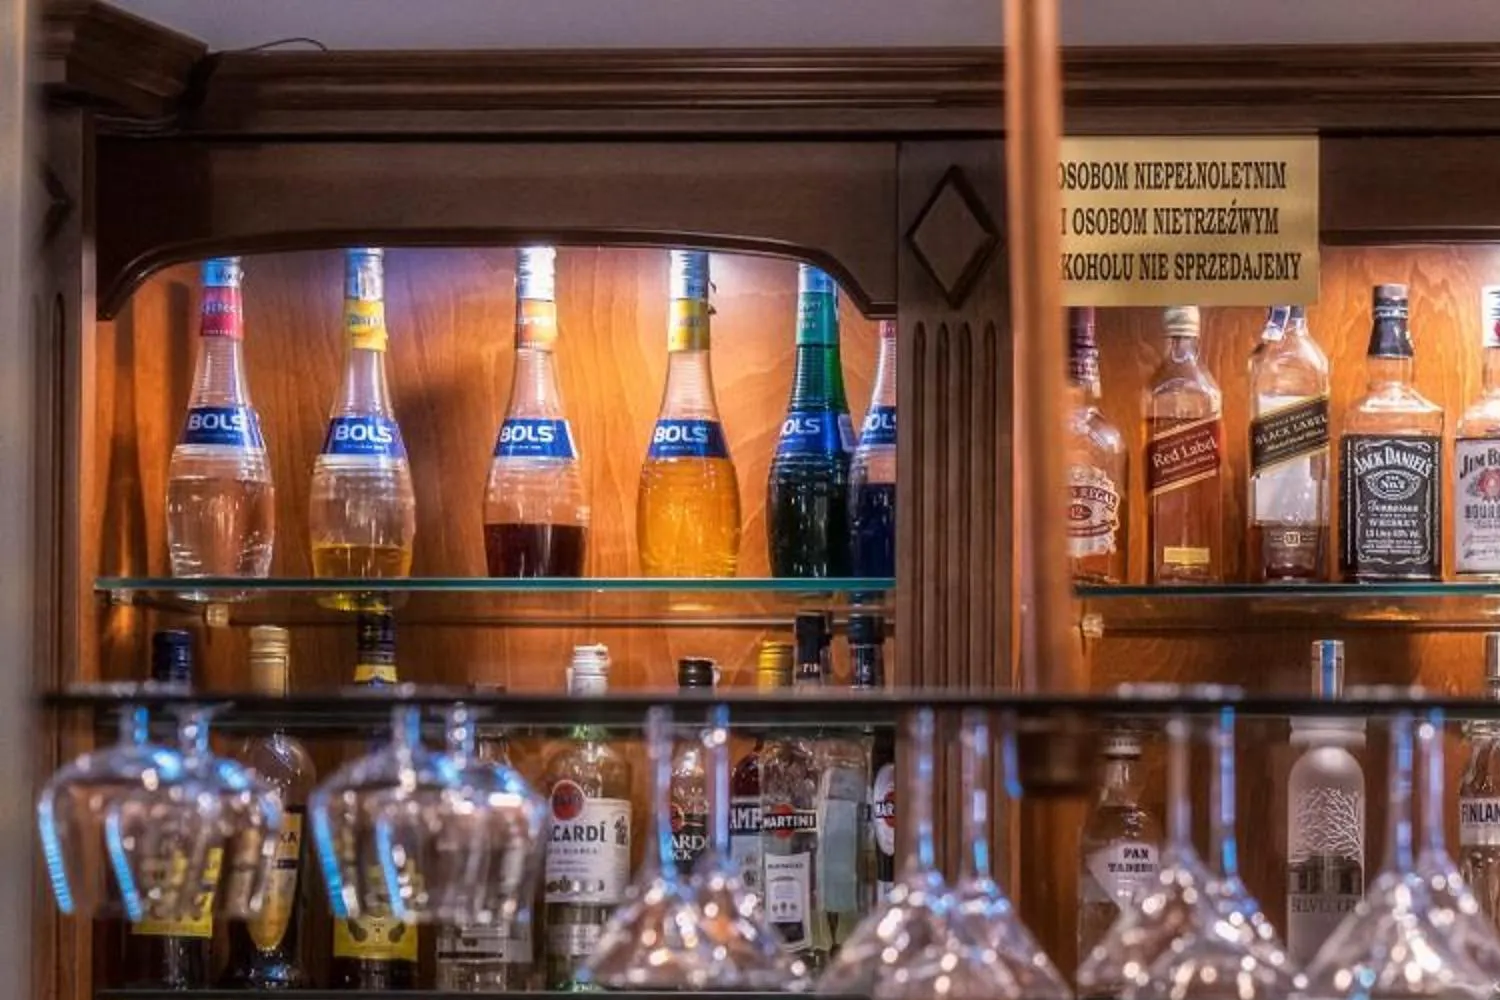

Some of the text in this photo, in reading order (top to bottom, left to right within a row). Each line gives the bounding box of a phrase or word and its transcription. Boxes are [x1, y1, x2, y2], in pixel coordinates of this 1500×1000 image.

[1133, 161, 1287, 190] NIEPEŁNOLETNIM
[1073, 207, 1148, 235] OSOBOM
[1153, 198, 1279, 235] NIETRZEŹWYM
[1062, 253, 1302, 281] KOHOLU NIE SPRZEDAJEMY
[187, 412, 245, 433] BOLS
[334, 423, 393, 444] BOLS
[781, 417, 821, 435] OLS
[1293, 414, 1327, 432] LABEL
[500, 425, 555, 443] BOLS
[653, 425, 709, 444] BOLS
[1152, 436, 1218, 467] Red Label
[1354, 450, 1384, 475] JACK
[1459, 453, 1486, 479] JIM
[550, 820, 607, 843] CARDÍ
[763, 815, 815, 828] MARTINI
